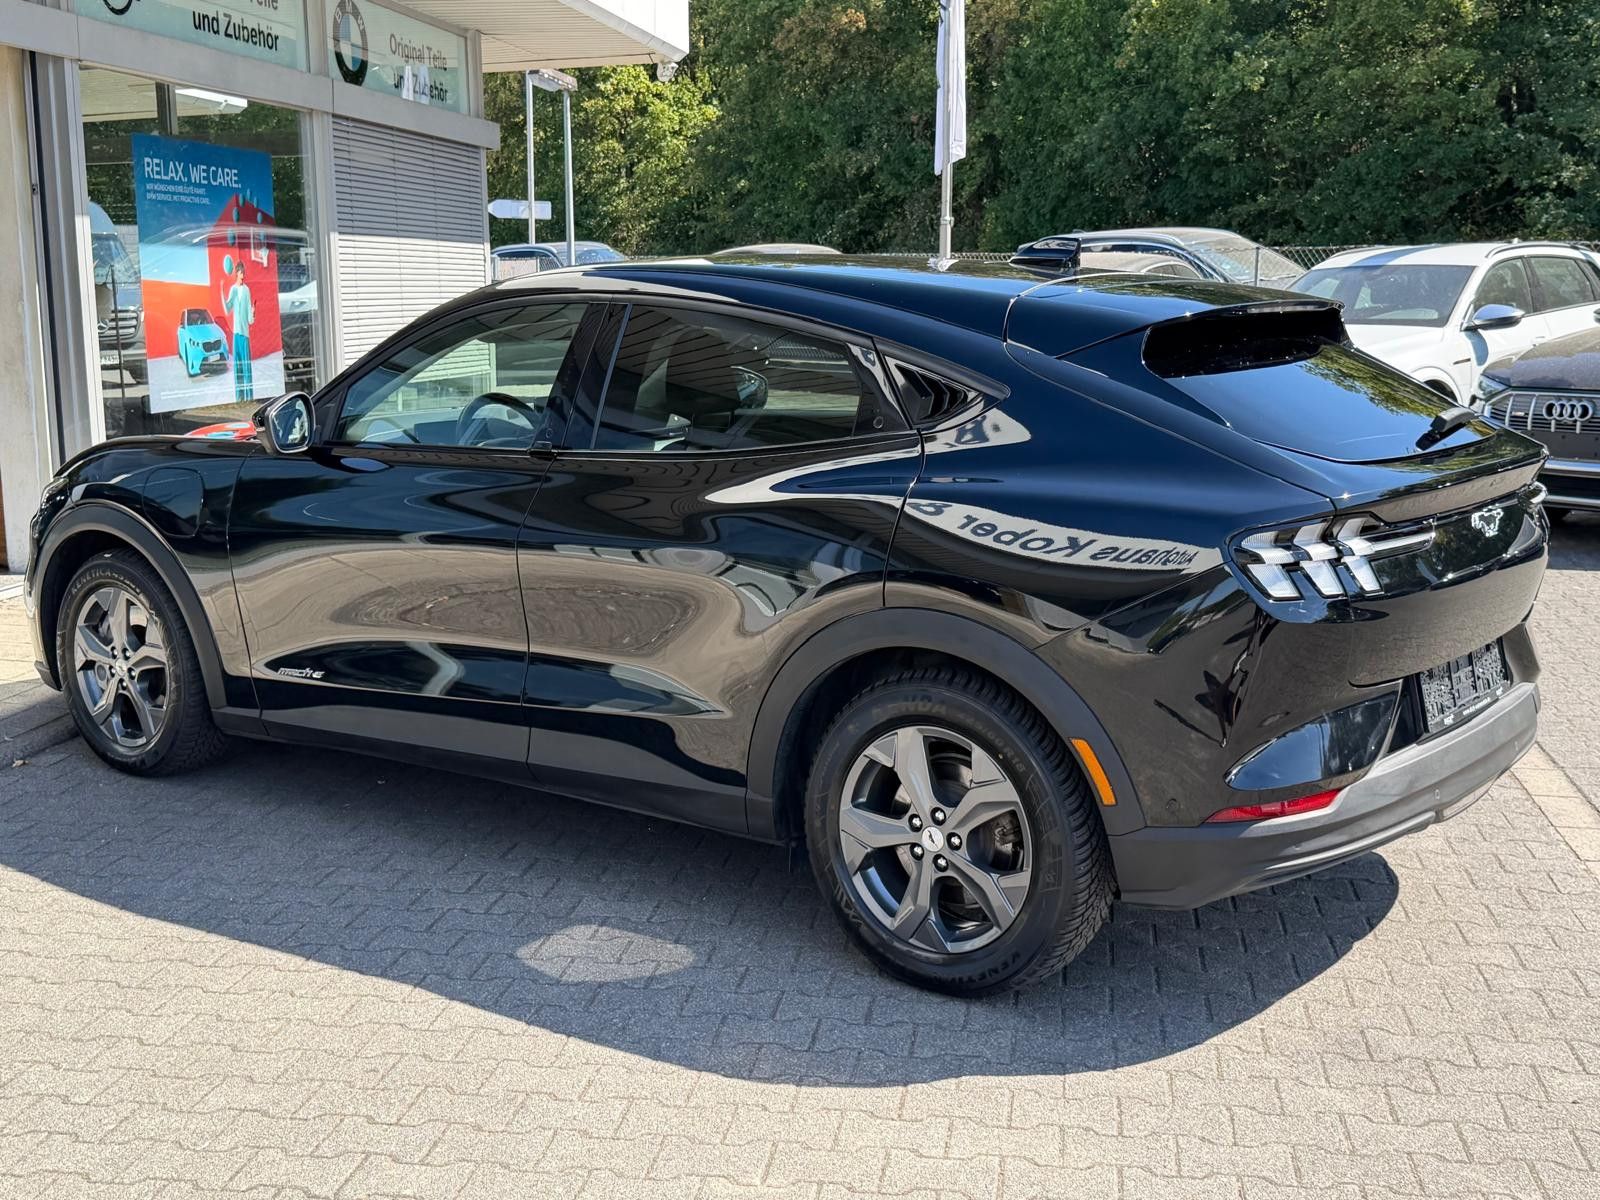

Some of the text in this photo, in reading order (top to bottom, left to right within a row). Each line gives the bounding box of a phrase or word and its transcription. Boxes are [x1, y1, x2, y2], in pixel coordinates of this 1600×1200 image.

[192, 11, 279, 51] und Zubehör
[389, 33, 448, 71] Original Teile
[144, 157, 242, 188] RELAX. WE CARE.
